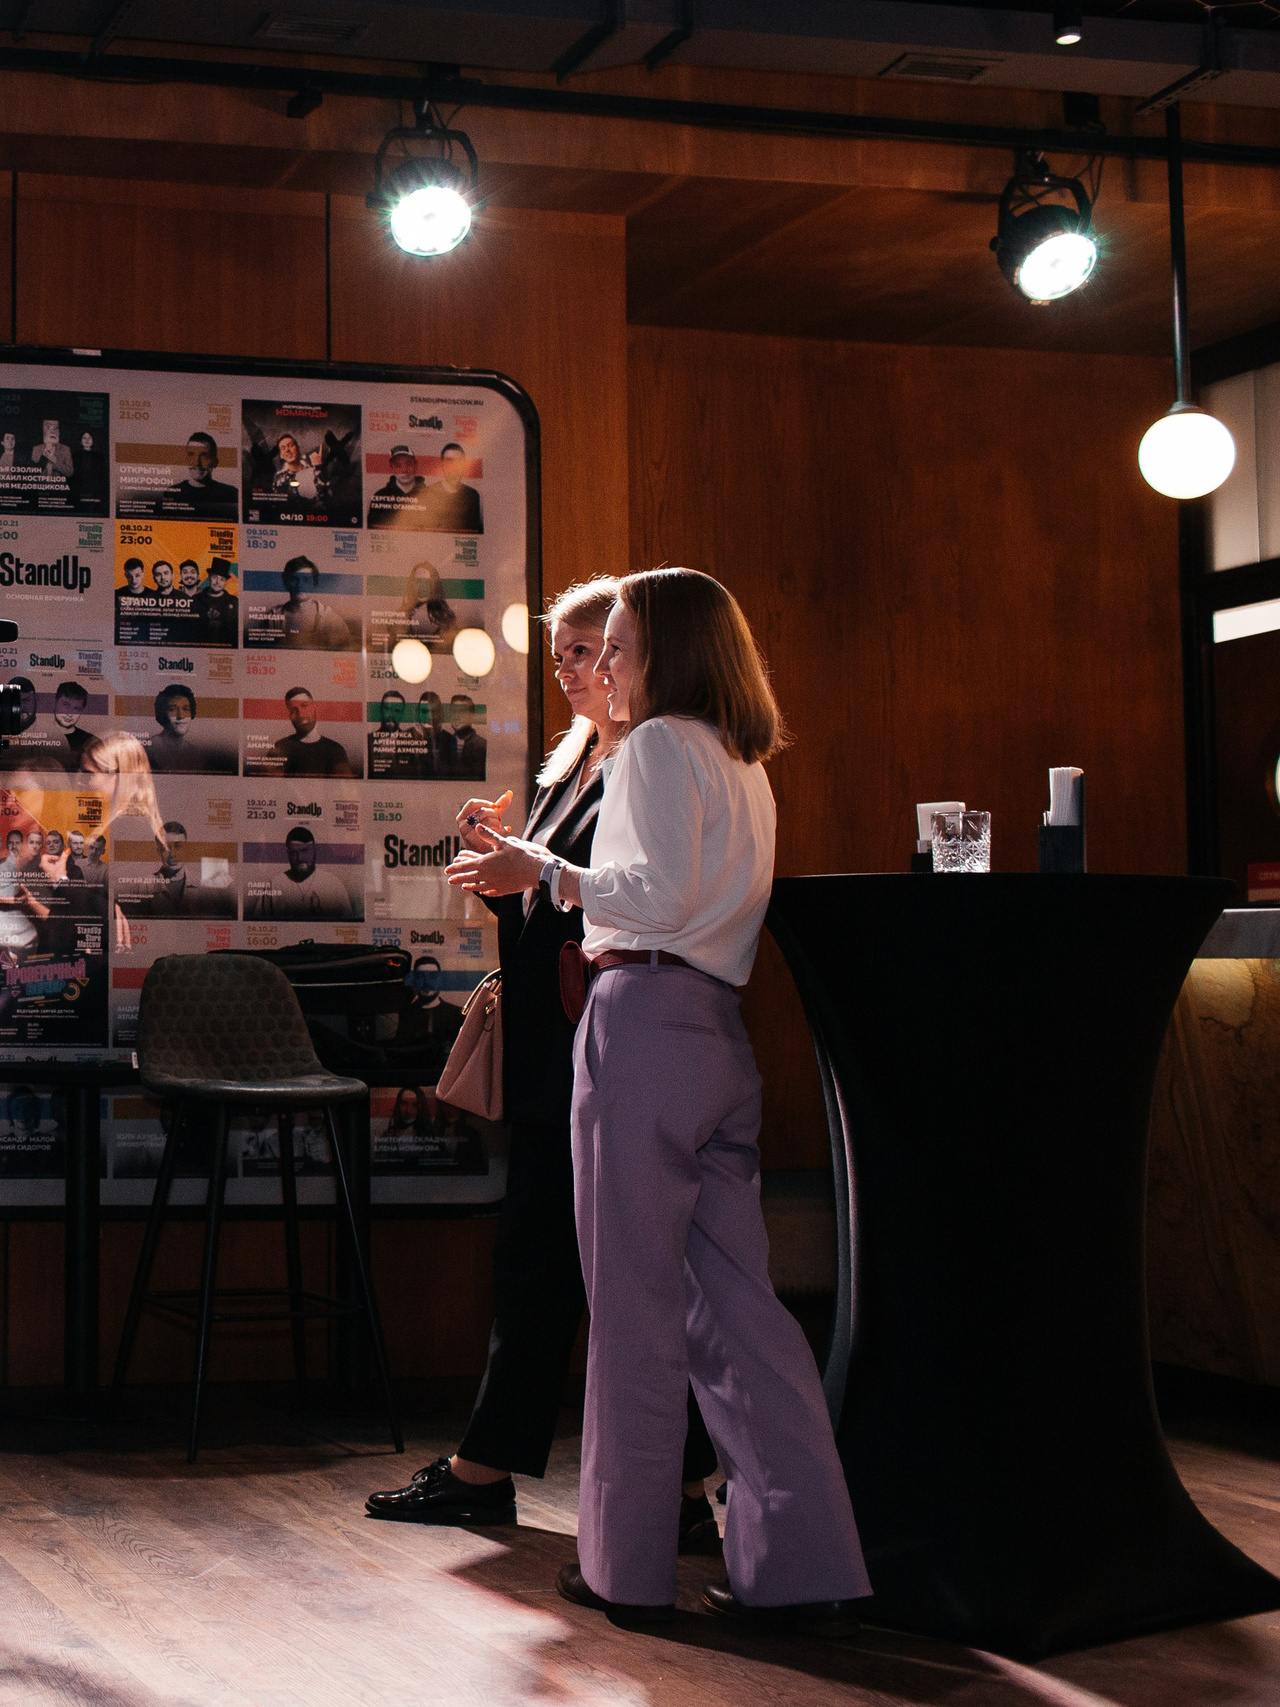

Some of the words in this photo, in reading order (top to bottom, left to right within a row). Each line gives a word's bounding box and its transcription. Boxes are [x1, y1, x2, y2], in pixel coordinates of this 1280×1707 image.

[119, 411, 150, 420] 21:00
[275, 409, 328, 418] КОМАНДЫ
[409, 414, 443, 430] StandUp
[120, 466, 172, 475] ОТКРЫТЫЙ
[23, 475, 66, 483] КОСТРЕЦОВ
[120, 476, 174, 485] МИКРОФОН
[11, 483, 70, 491] МЕДОВЩИКОВА
[280, 513, 304, 521] 04/10
[120, 524, 153, 532] 08.10.21
[246, 528, 278, 537] 09.10.21
[120, 535, 153, 545] 23:00
[246, 539, 276, 549] 18:30
[0, 551, 91, 594] StandUp
[120, 596, 157, 607] STAND
[159, 598, 173, 607] UP
[175, 599, 194, 608] ЮГ
[29, 653, 65, 669] StandUp
[158, 656, 194, 673] StandUp
[119, 662, 148, 671] 21:30
[246, 665, 276, 675] 18:30
[20, 739, 61, 747] ШАМУТИЛО
[247, 799, 277, 807] 19.10.21
[373, 801, 404, 809] 20.10.21
[287, 801, 323, 818] StandUp
[247, 810, 276, 820] 21:30
[373, 812, 403, 822] 18:30
[77, 926, 102, 935] StandUp
[85, 933, 101, 941] Store
[247, 937, 278, 946] 16:00
[410, 930, 445, 946] StandUp
[77, 940, 101, 948] Moscow
